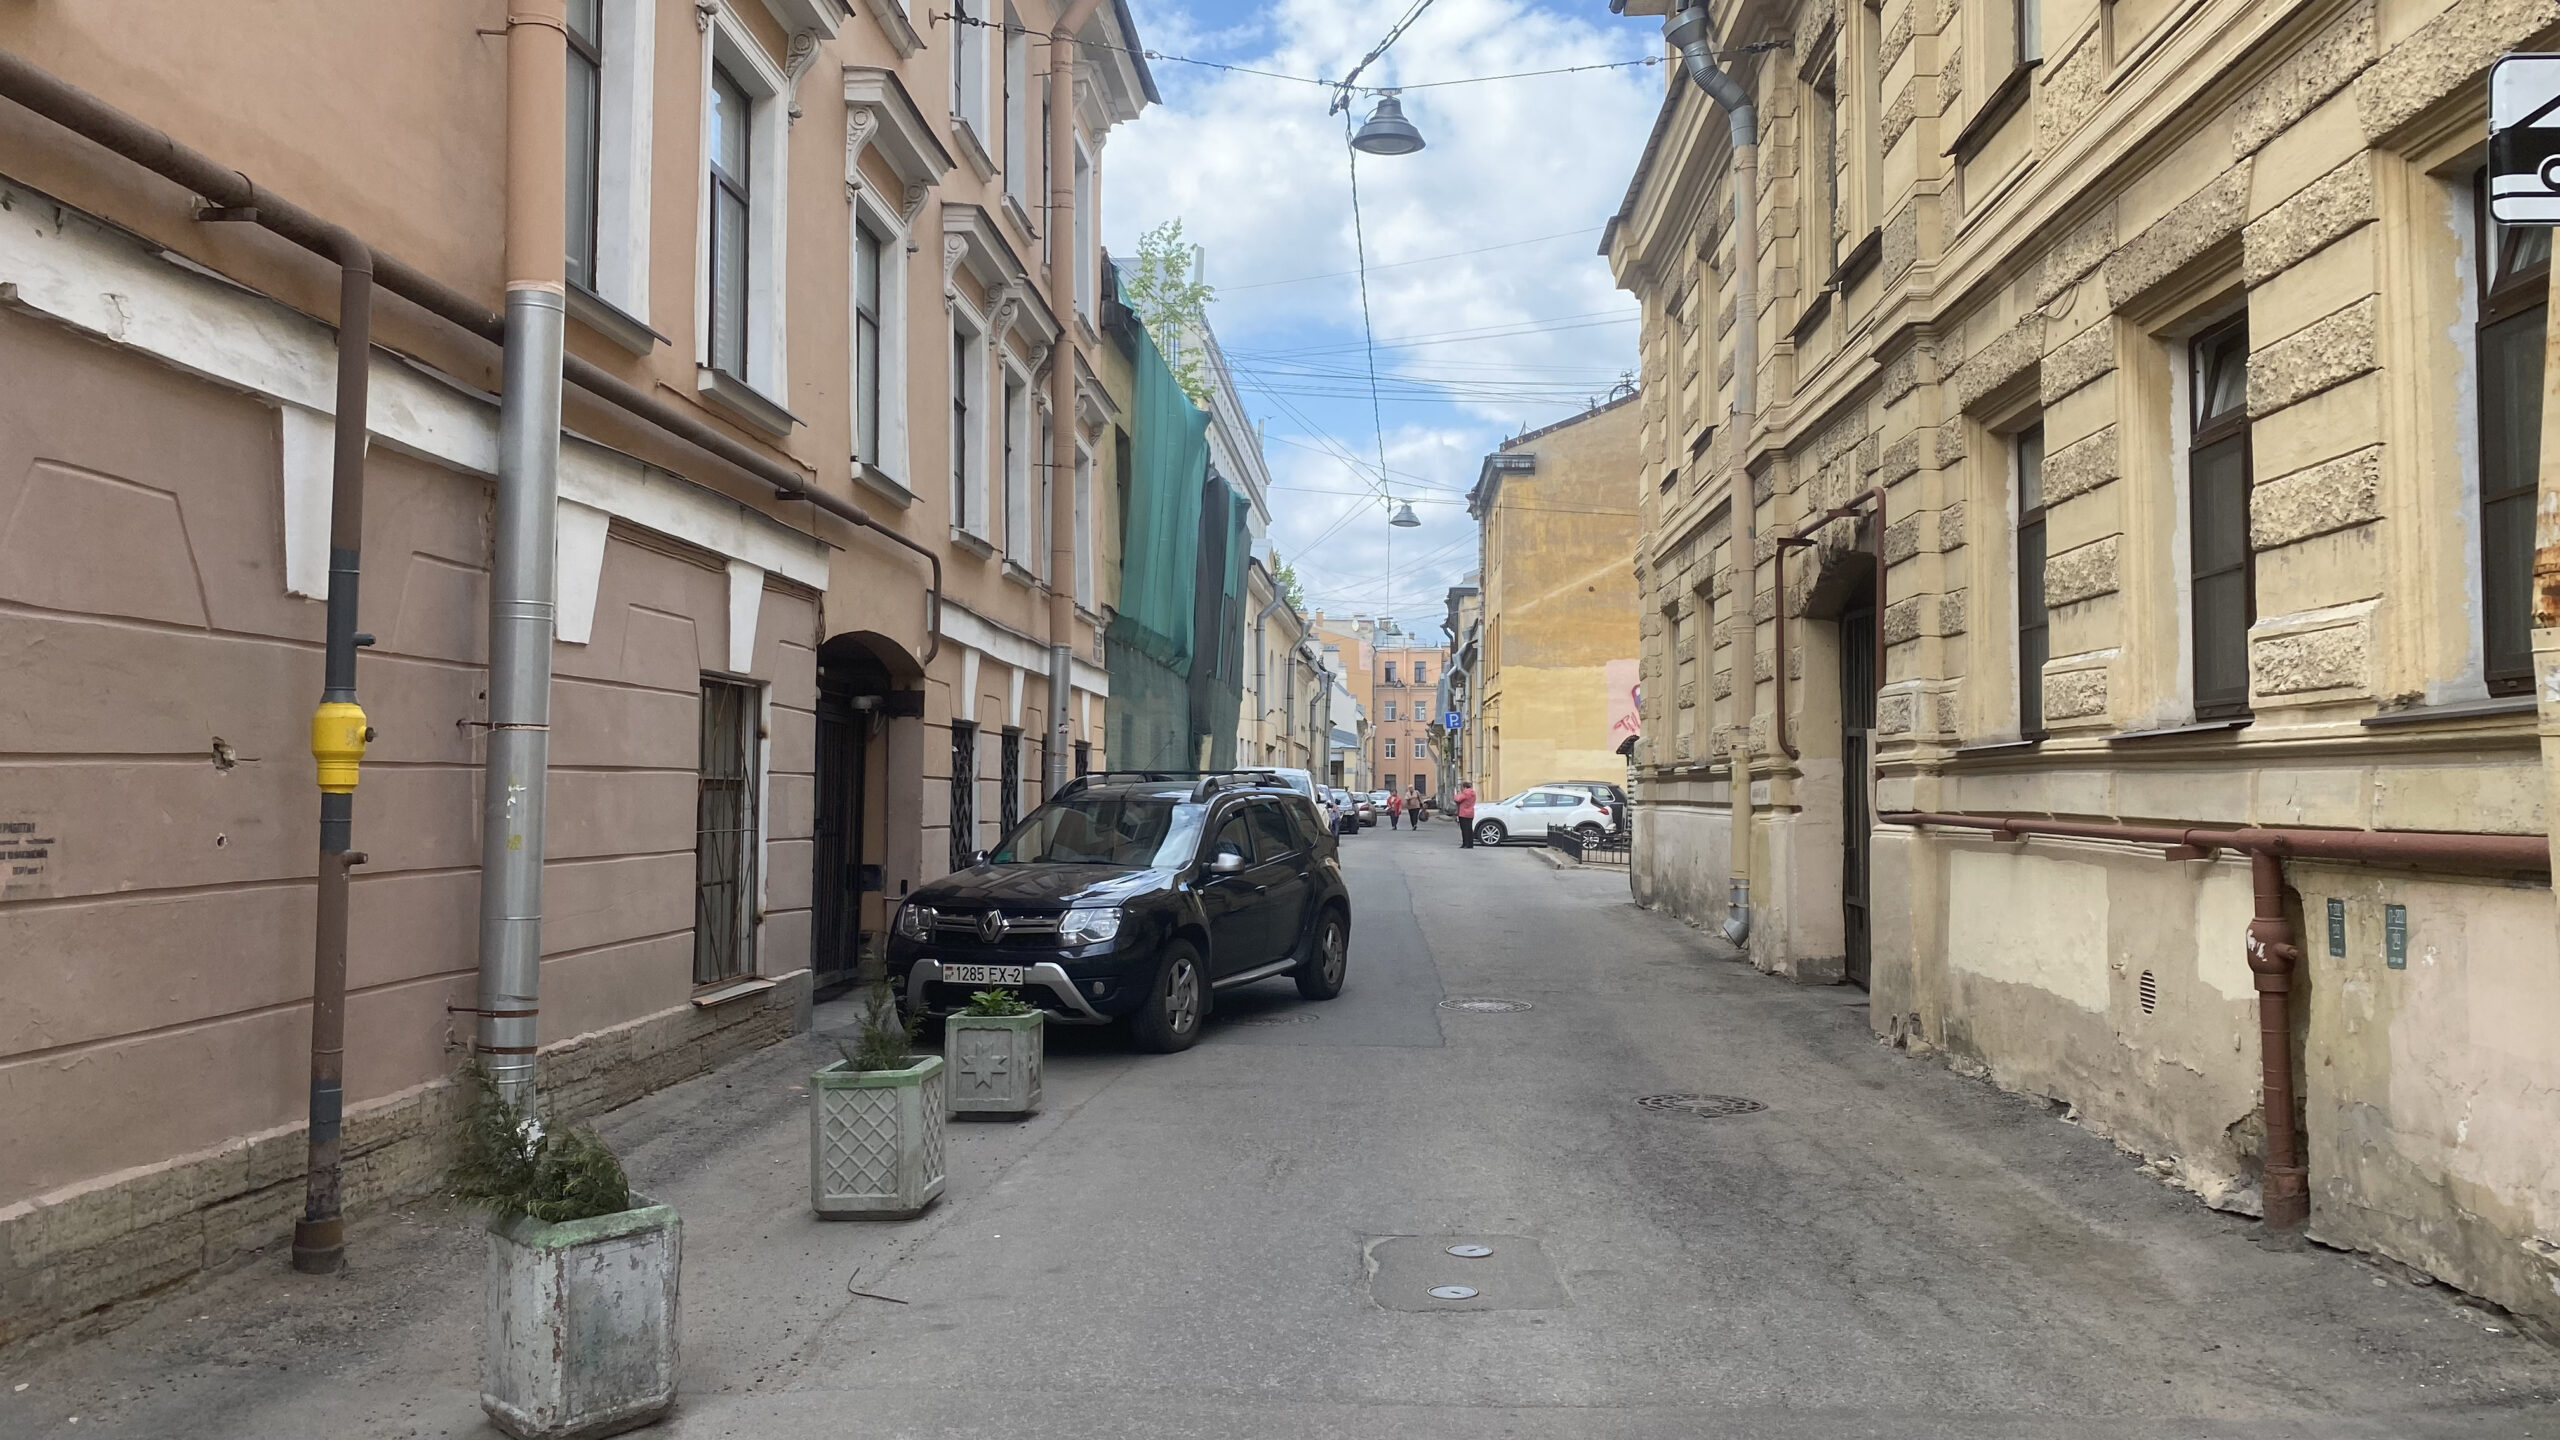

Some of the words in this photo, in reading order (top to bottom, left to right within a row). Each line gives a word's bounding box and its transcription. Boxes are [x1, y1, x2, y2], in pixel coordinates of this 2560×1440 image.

[1449, 713, 1459, 727] P
[956, 966, 984, 982] 1285
[989, 967, 1021, 983] EX-2
